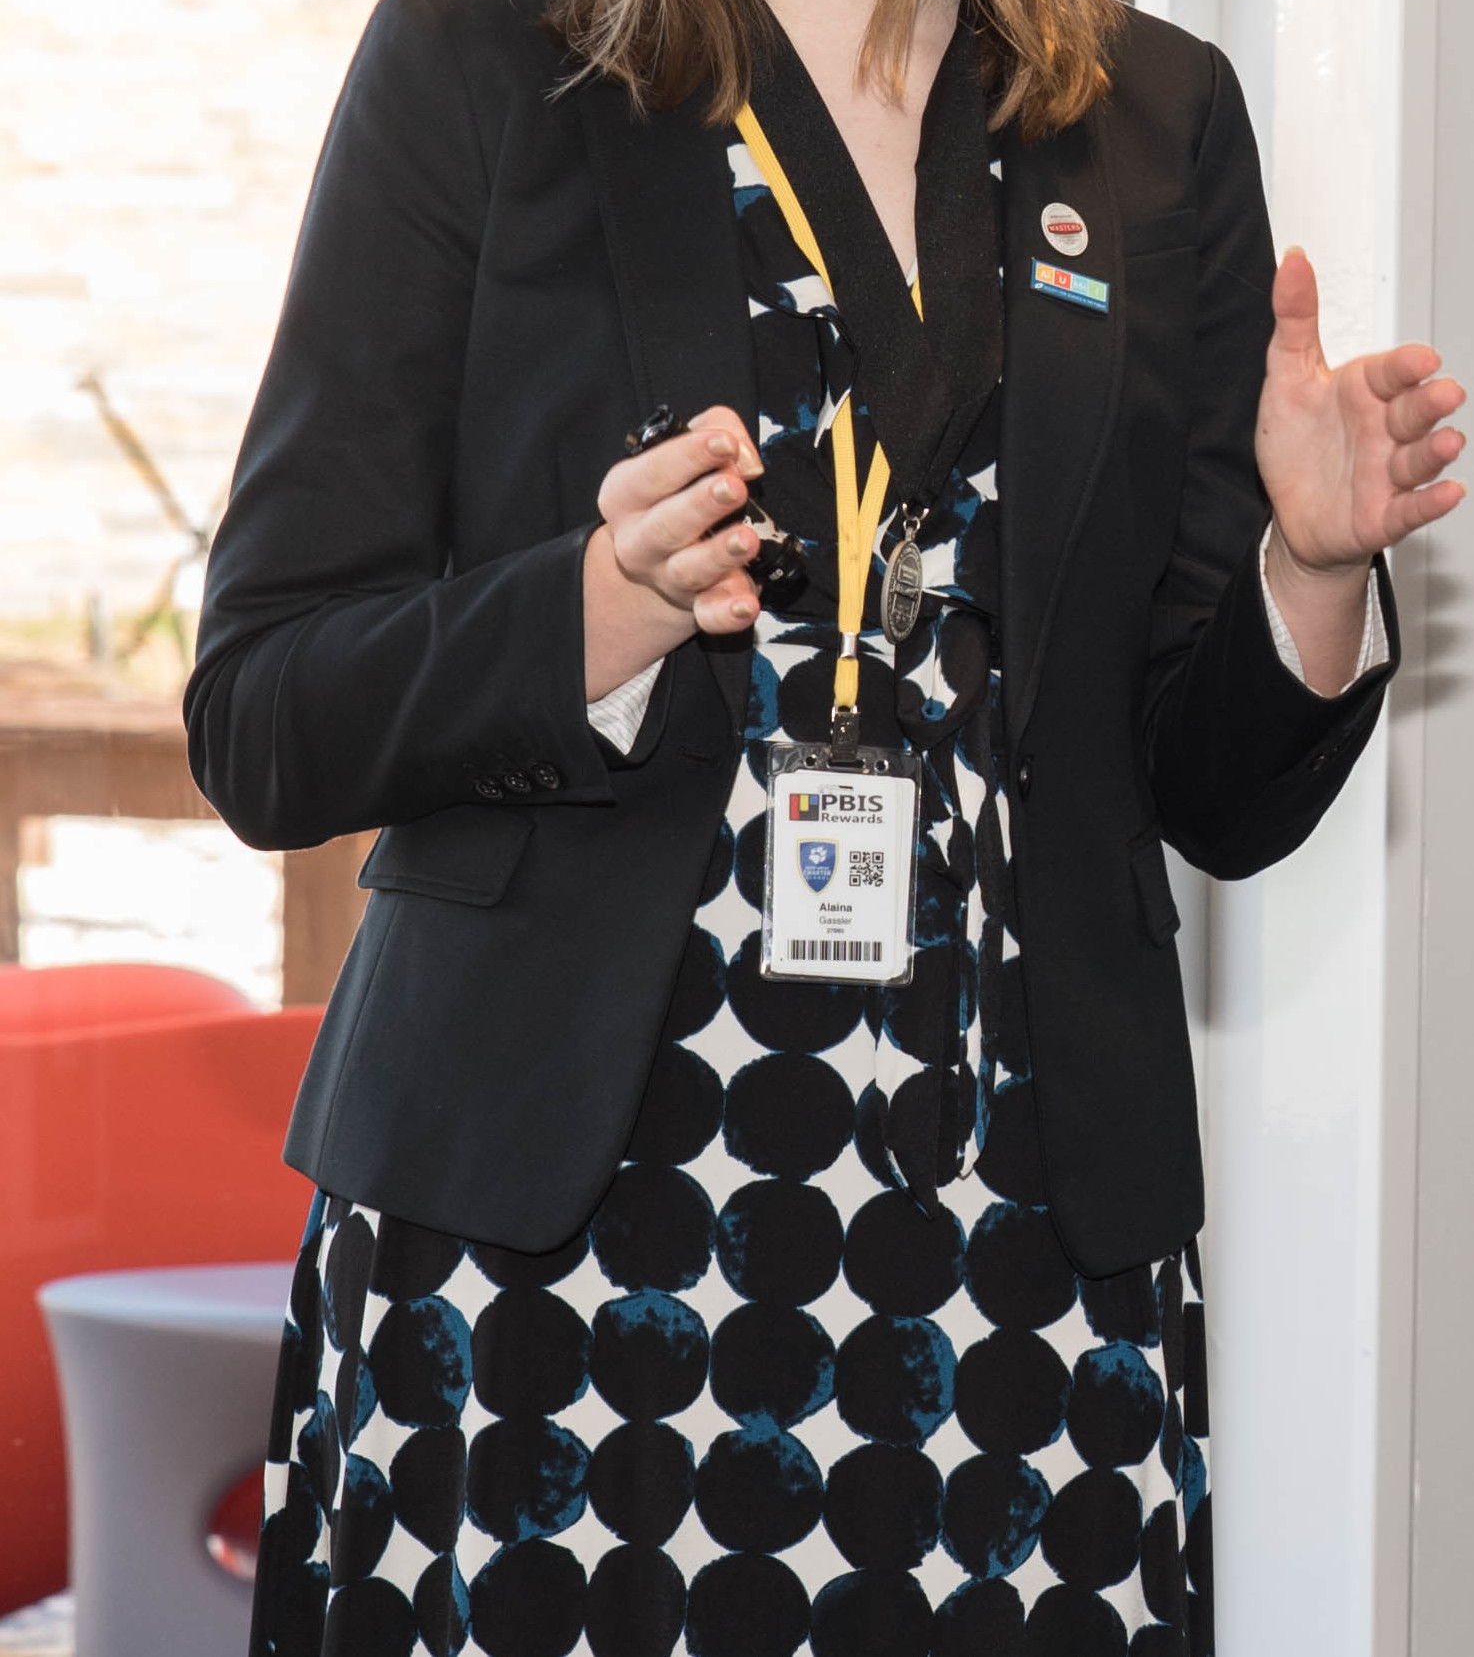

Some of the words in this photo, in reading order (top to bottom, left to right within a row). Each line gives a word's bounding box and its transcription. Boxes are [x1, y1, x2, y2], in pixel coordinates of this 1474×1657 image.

[821, 794, 883, 812] PBIS
[821, 812, 883, 823] Rewards
[819, 903, 853, 912] Alaina
